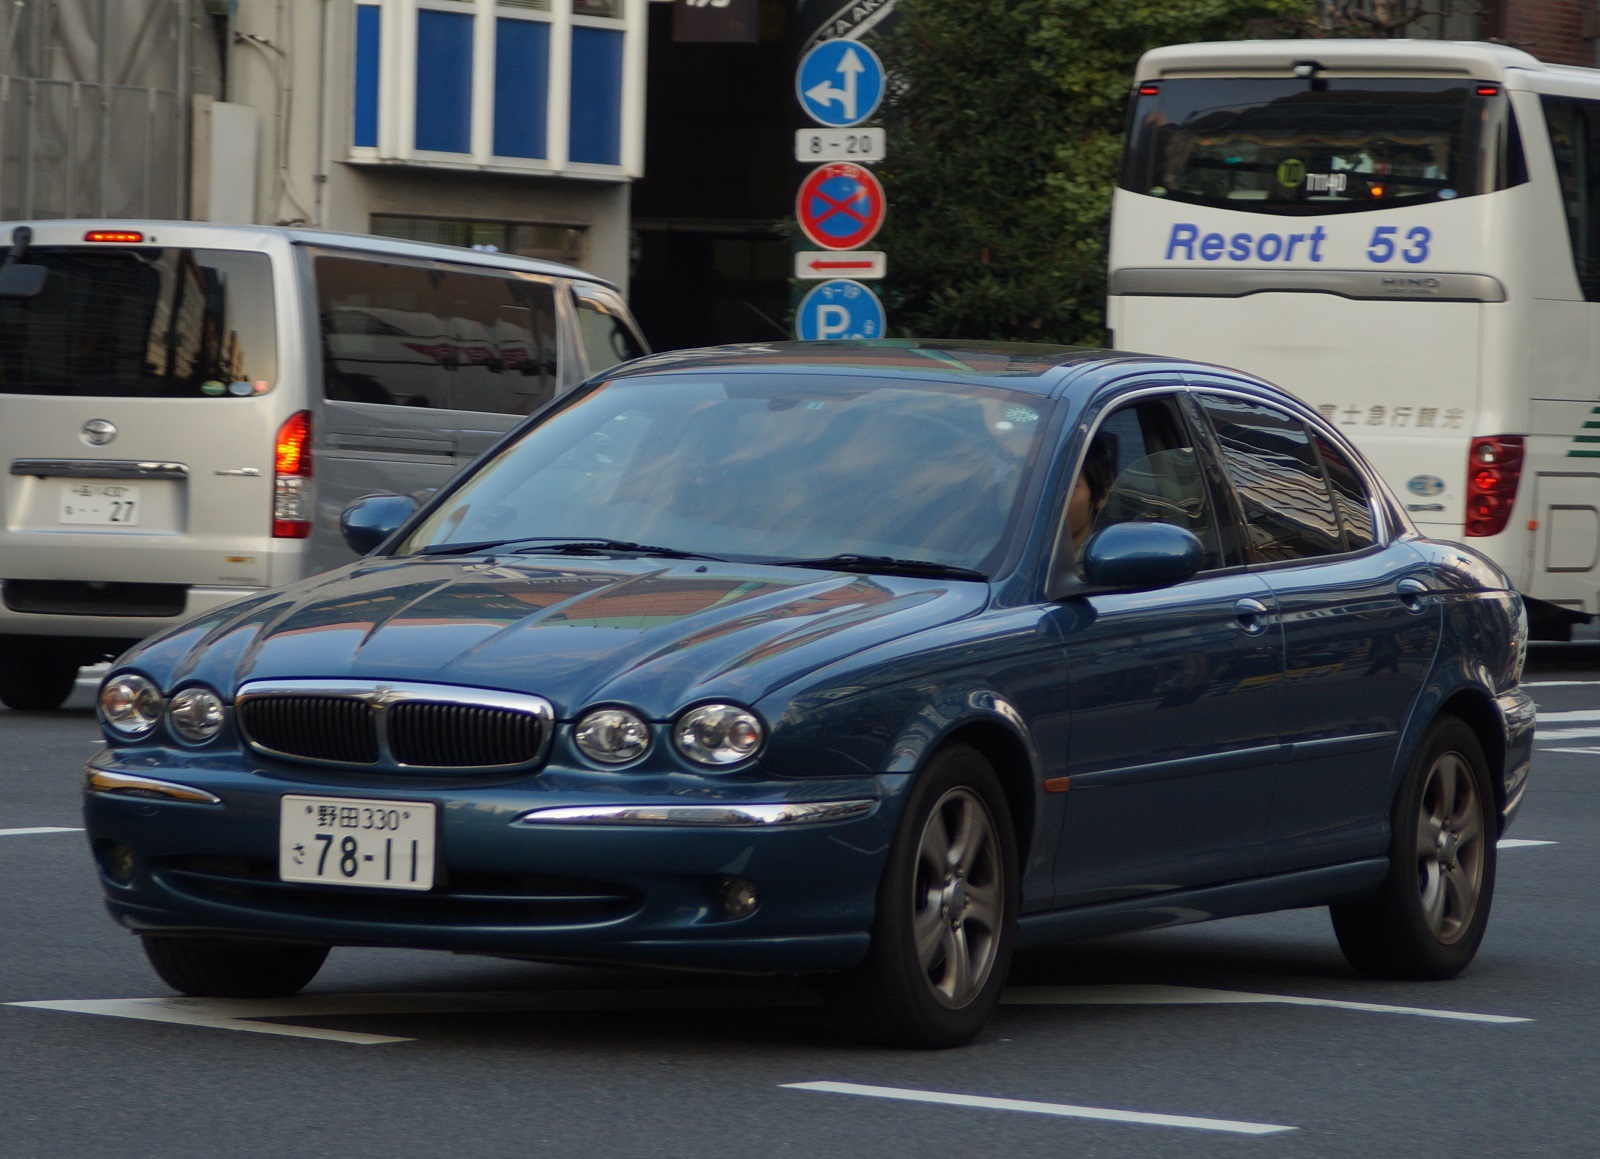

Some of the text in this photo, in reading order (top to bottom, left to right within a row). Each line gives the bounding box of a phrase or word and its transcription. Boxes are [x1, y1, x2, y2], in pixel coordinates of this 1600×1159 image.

[810, 136, 872, 154] 8-20
[1165, 223, 1432, 264] Resort 53
[1382, 277, 1440, 287] HINO
[816, 304, 851, 340] P
[317, 805, 399, 831] 野田330
[314, 833, 418, 882] 78-11
